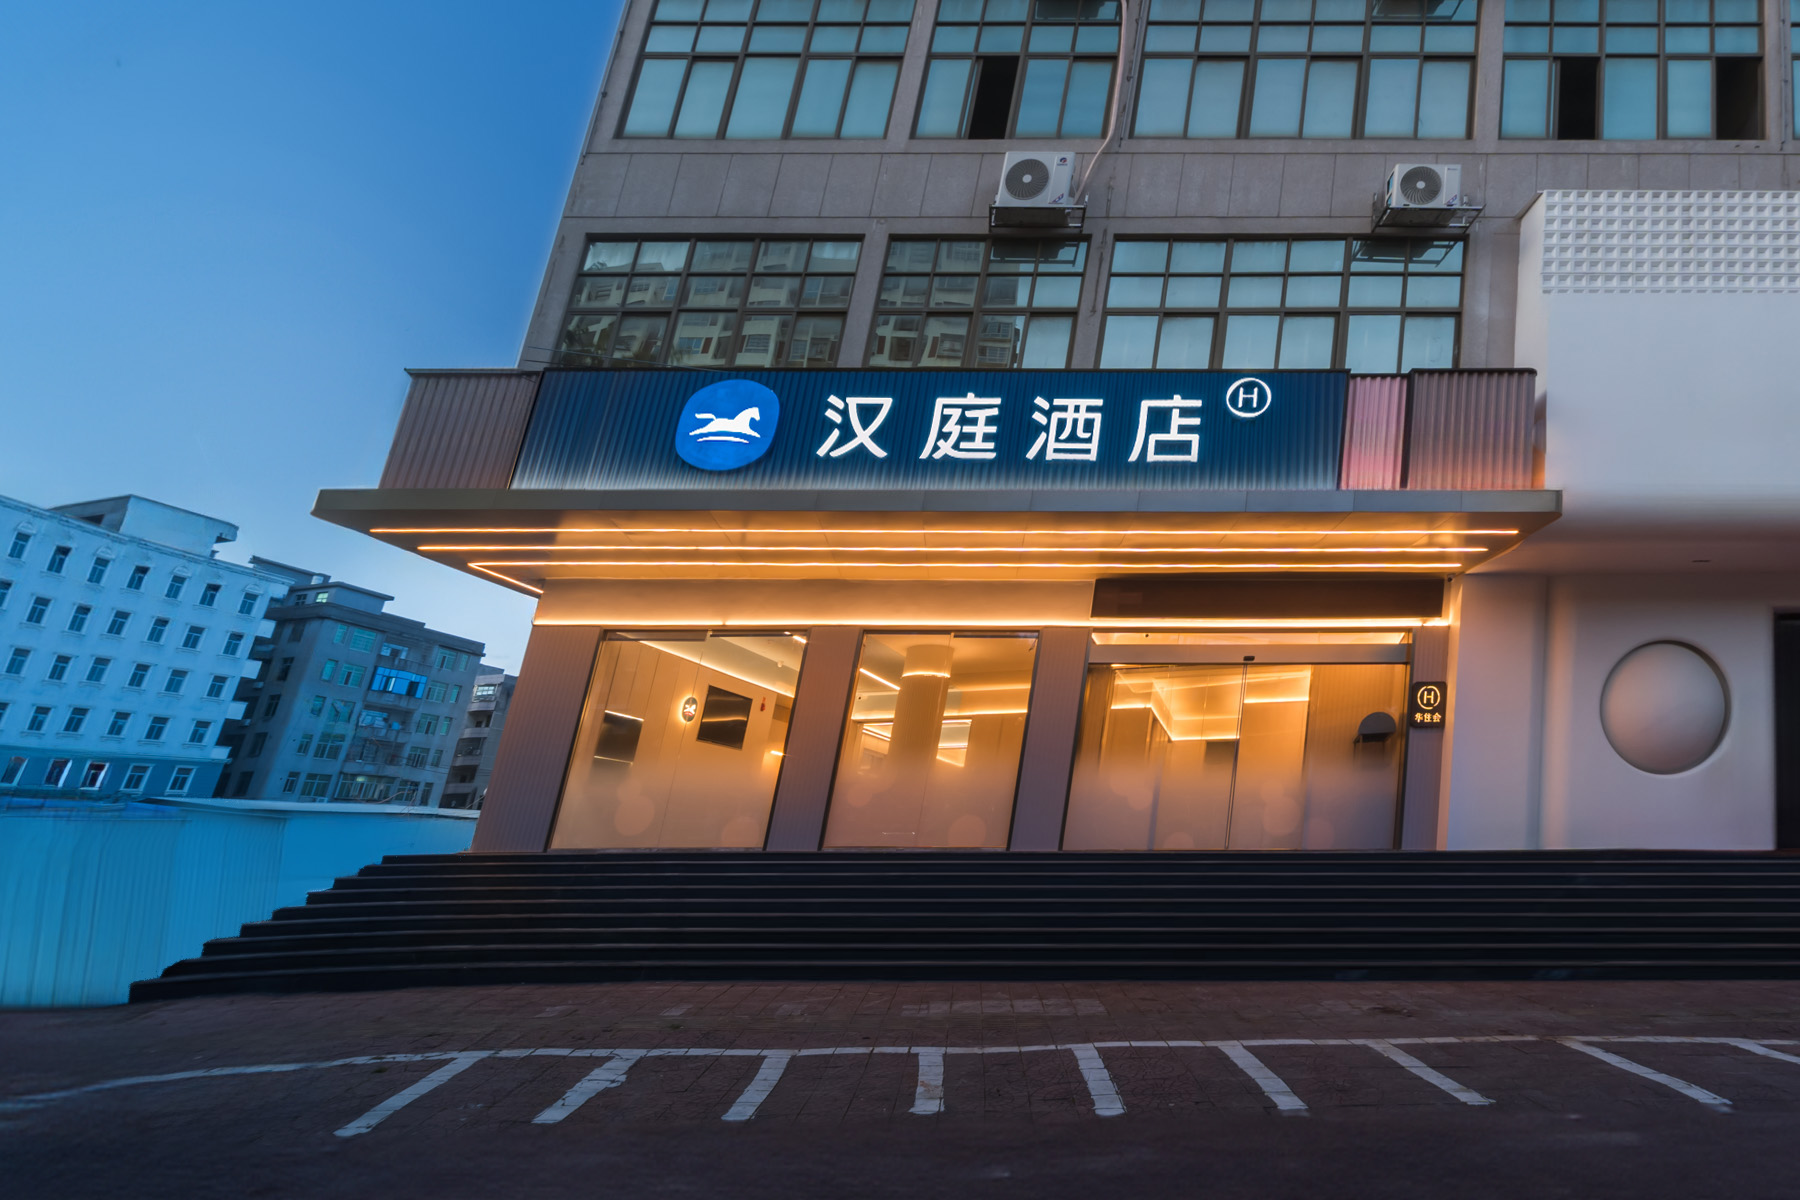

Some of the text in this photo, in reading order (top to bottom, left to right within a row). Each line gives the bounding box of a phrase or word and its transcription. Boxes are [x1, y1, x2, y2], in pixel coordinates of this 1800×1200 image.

[816, 392, 1203, 463] 汉庭酒店
[1414, 712, 1442, 723] 华住会
